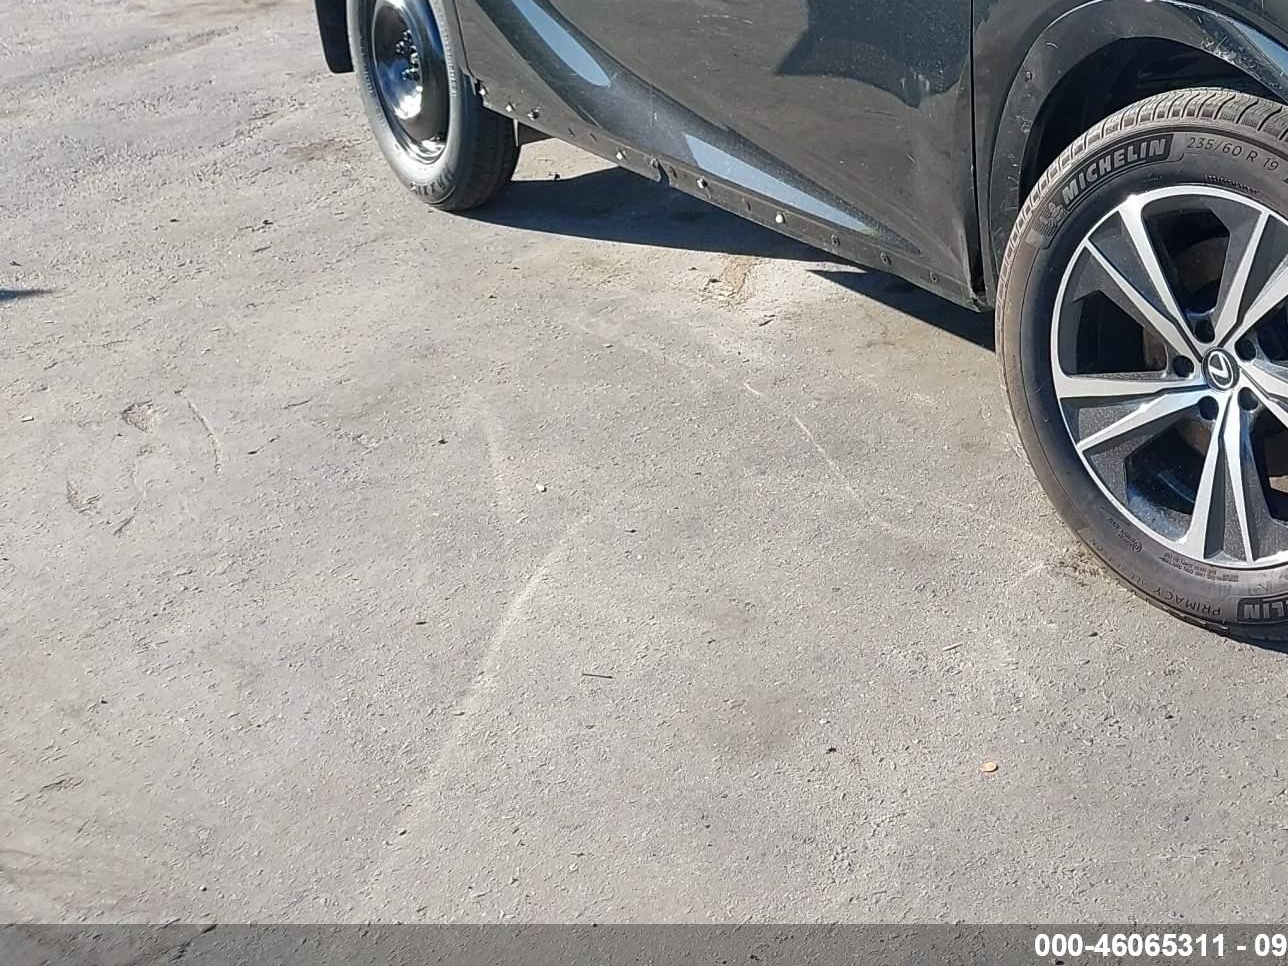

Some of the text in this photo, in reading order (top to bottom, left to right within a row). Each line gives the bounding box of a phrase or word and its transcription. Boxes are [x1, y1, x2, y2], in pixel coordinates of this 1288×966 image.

[1187, 136, 1279, 171] 235/60 R 19
[1062, 138, 1167, 205] MICHELIN
[1153, 586, 1221, 616] PRIMACY
